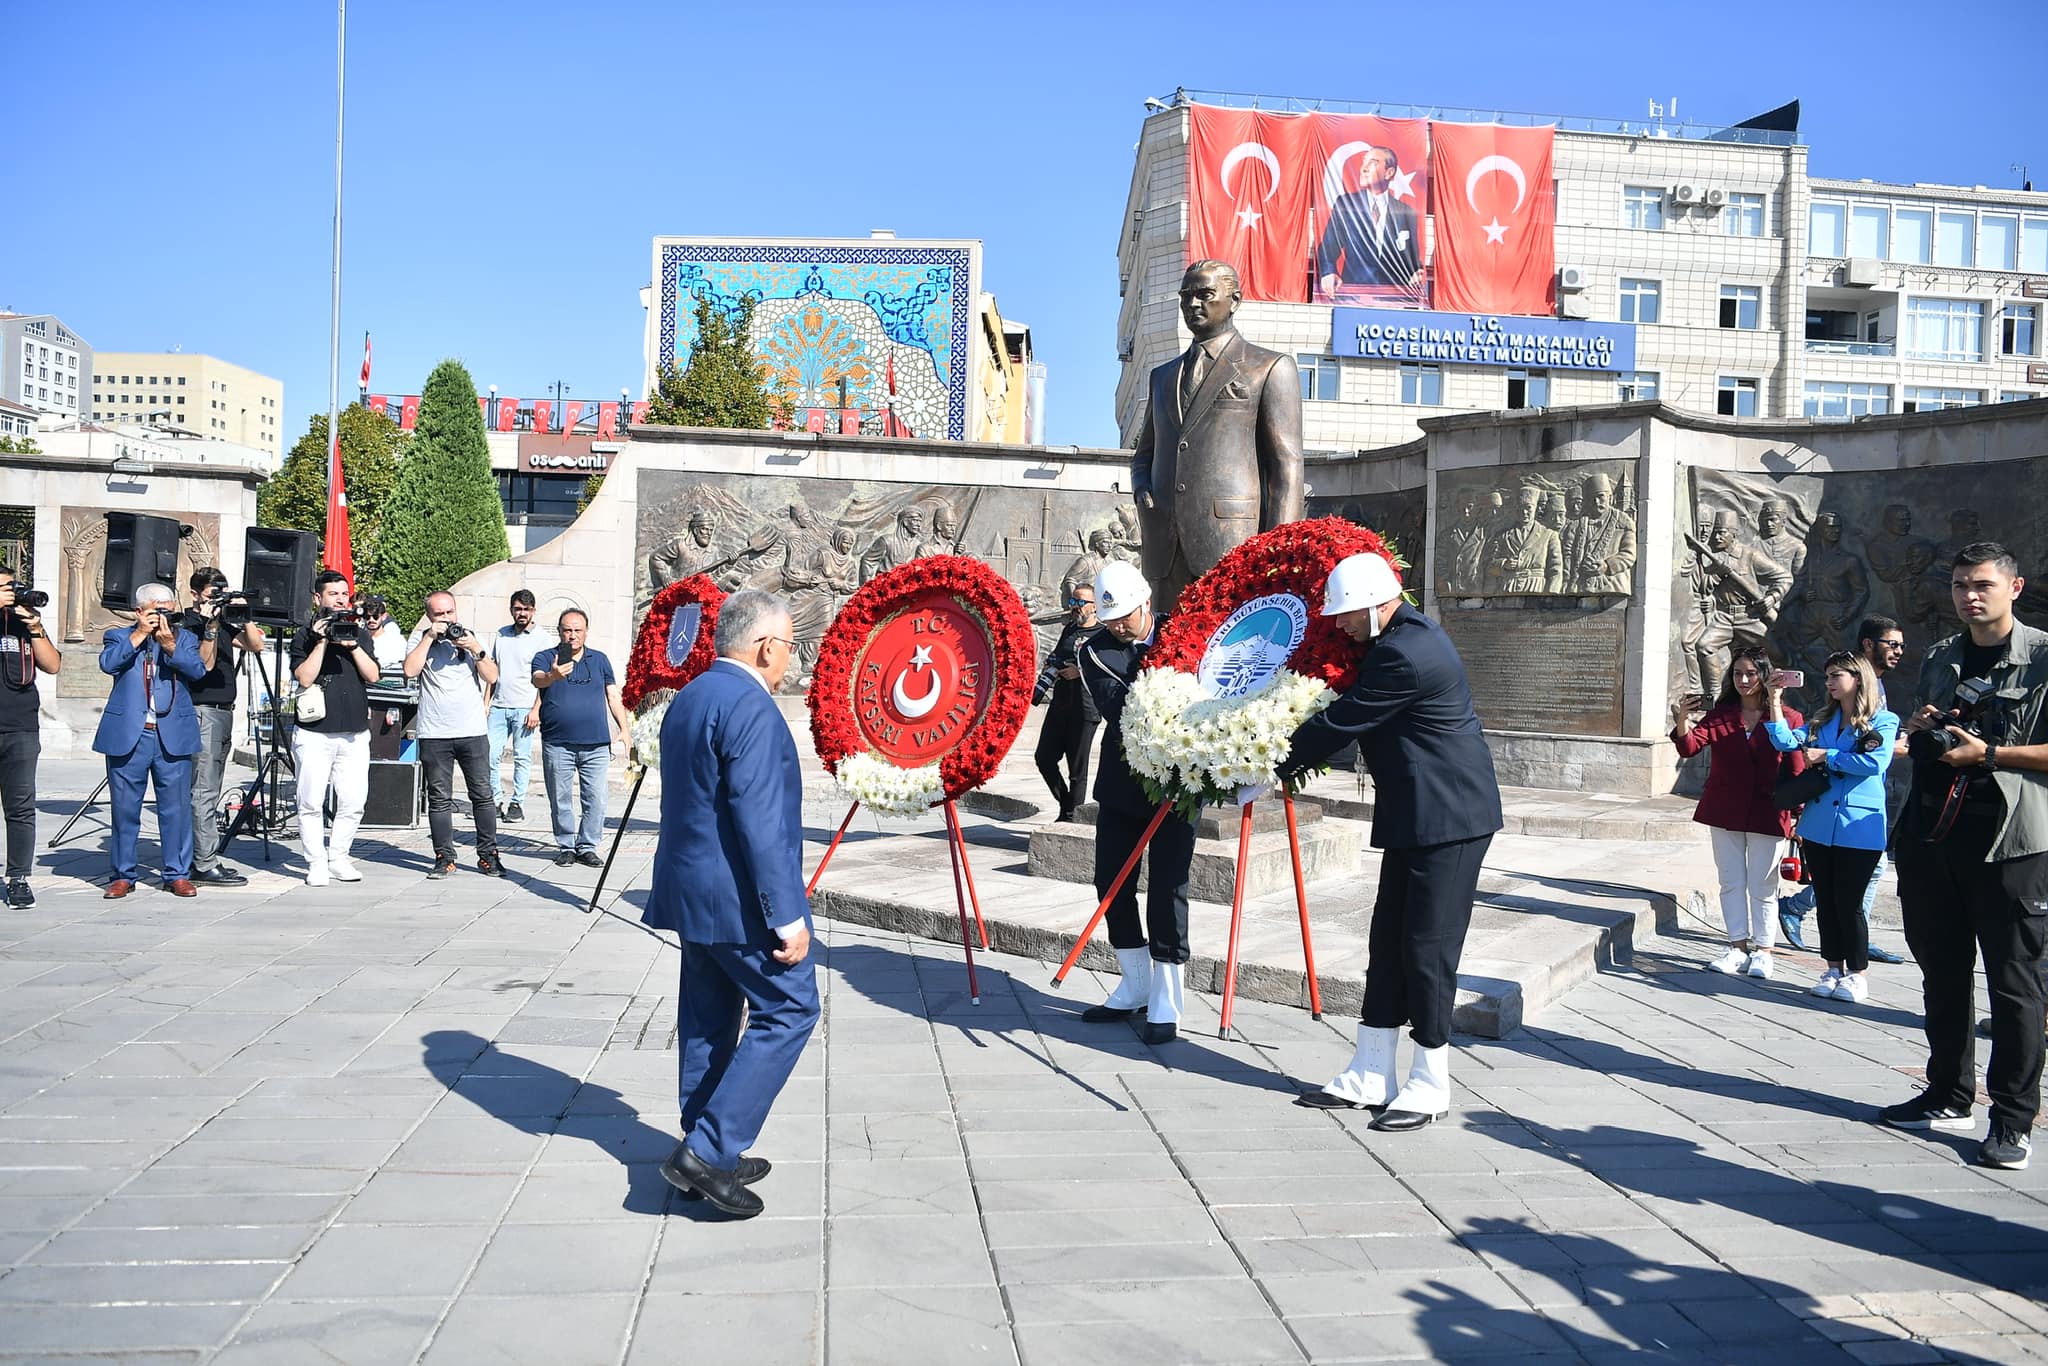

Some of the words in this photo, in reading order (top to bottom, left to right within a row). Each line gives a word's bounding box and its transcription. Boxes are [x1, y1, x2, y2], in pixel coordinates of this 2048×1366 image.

[1356, 323, 1465, 344] KOCASİNAN
[1471, 331, 1614, 352] KAYMAKAMLIĞI
[1470, 316, 1503, 332] T.C.
[1358, 337, 1402, 357] İLÇE
[1408, 342, 1490, 361] EMNİYET
[1495, 347, 1611, 367] MÜDÜRLÜĞÜ
[863, 661, 903, 745] KAYSERİ
